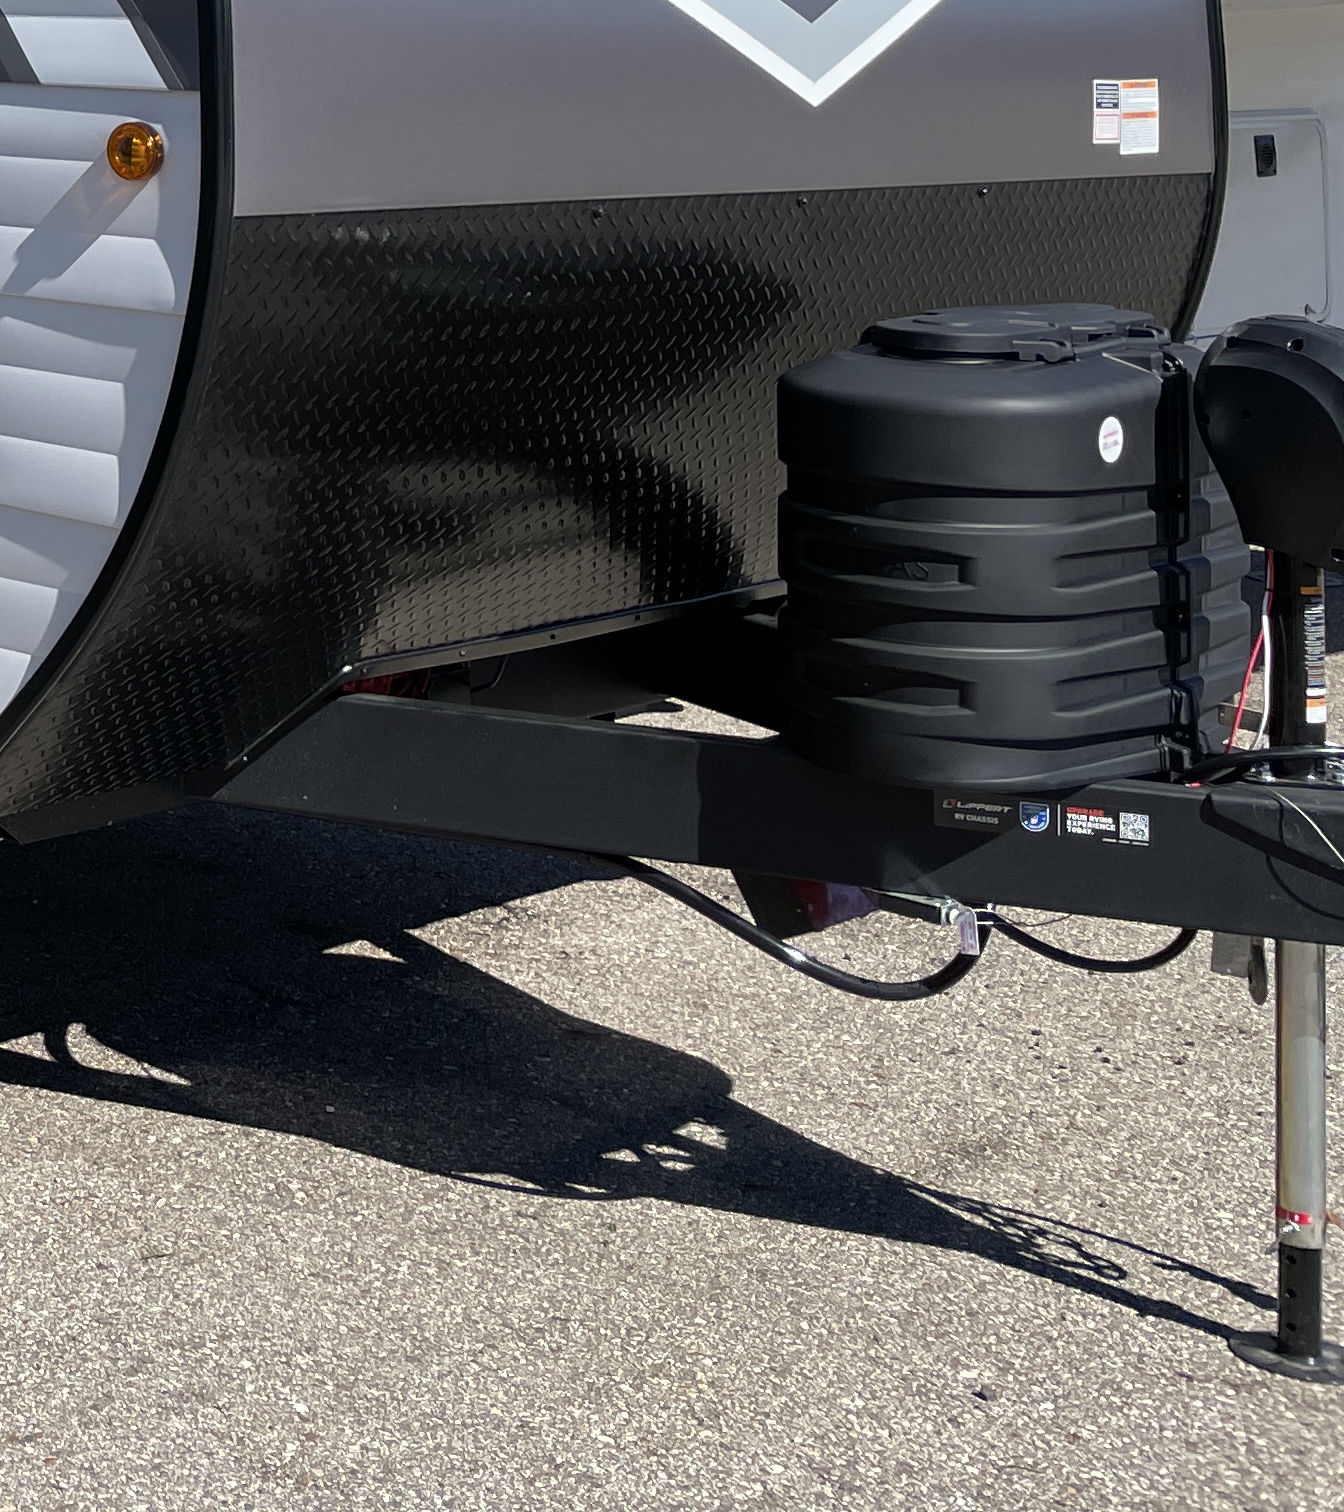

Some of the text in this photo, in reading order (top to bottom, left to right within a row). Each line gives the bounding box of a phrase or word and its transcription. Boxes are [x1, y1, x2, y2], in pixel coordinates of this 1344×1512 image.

[1066, 813, 1088, 822] YOUR
[1066, 819, 1116, 832] EXPERIENCE
[1066, 826, 1095, 836] TODAY.
